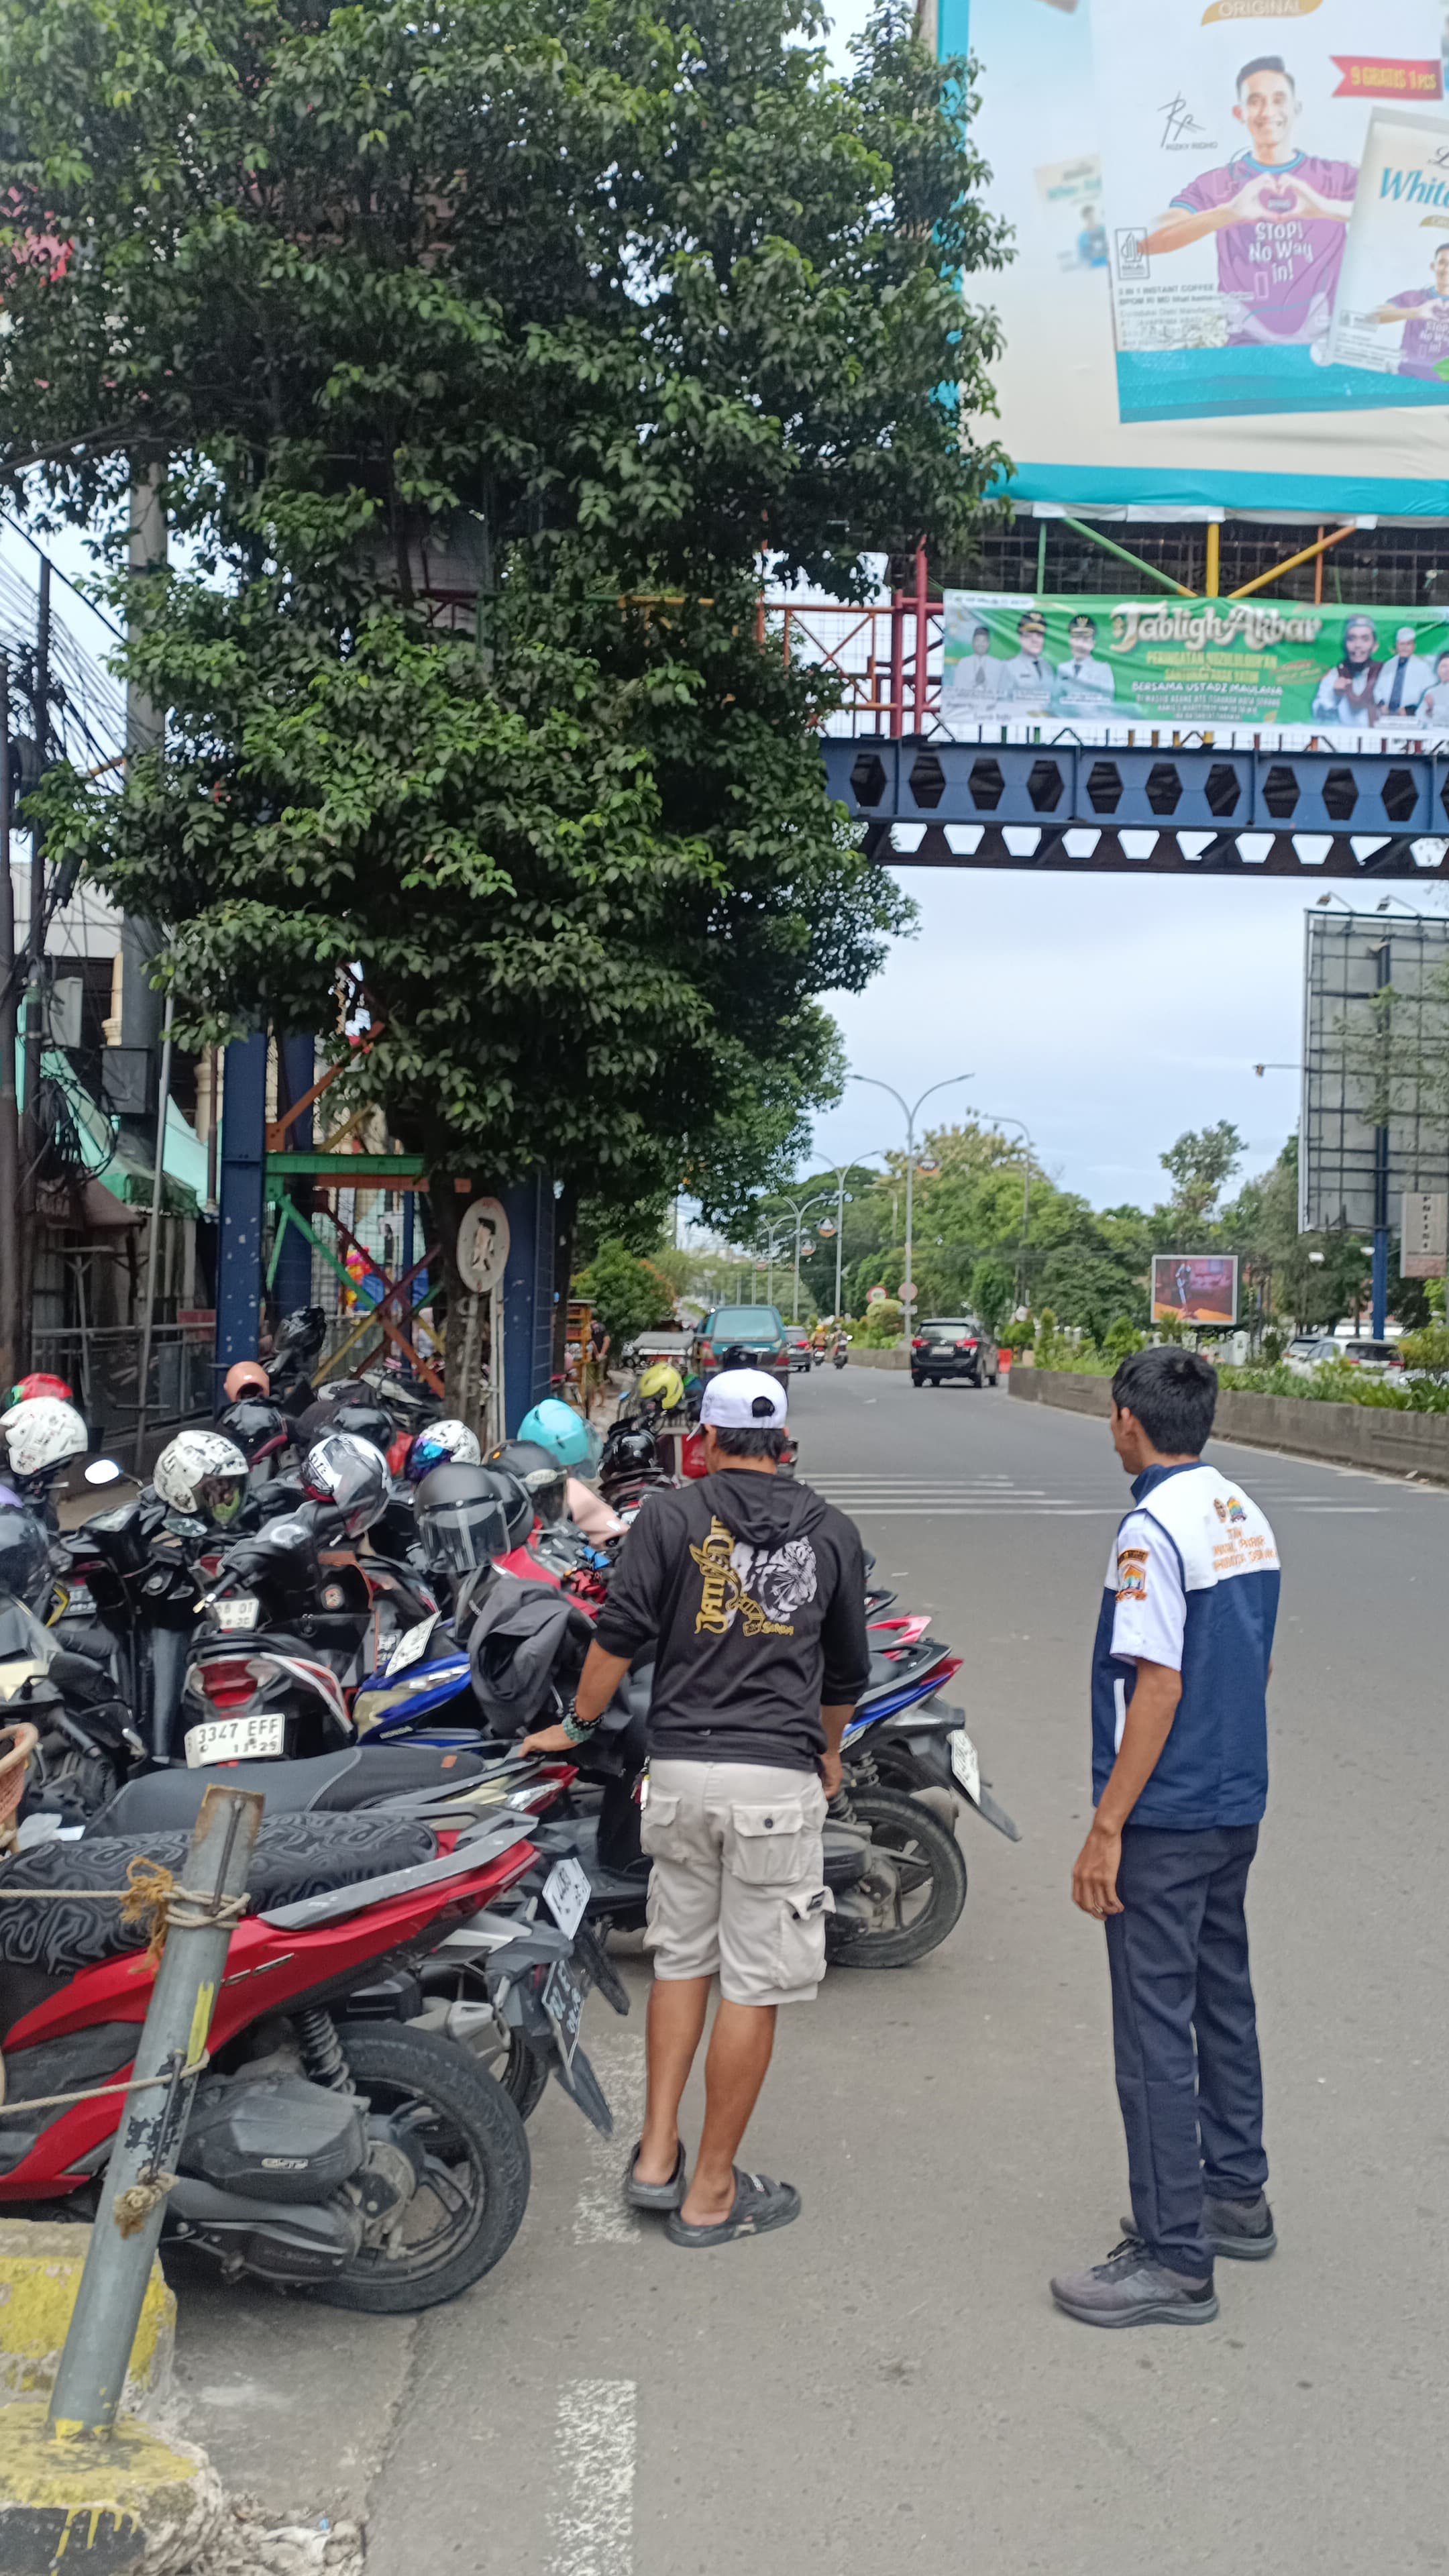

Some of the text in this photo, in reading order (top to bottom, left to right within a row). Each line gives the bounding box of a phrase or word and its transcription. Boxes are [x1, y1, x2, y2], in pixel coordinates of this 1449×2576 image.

[1218, 0, 1303, 17] ORIGINAL
[1248, 240, 1313, 263] No Way
[1272, 259, 1293, 284] in!
[1181, 283, 1214, 292] COFFEE
[1110, 600, 1322, 653] Tabligh Akbar
[1132, 681, 1283, 696] BERSAMA USTADZ MAULANA
[199, 1718, 279, 1745] 3347 EFF
